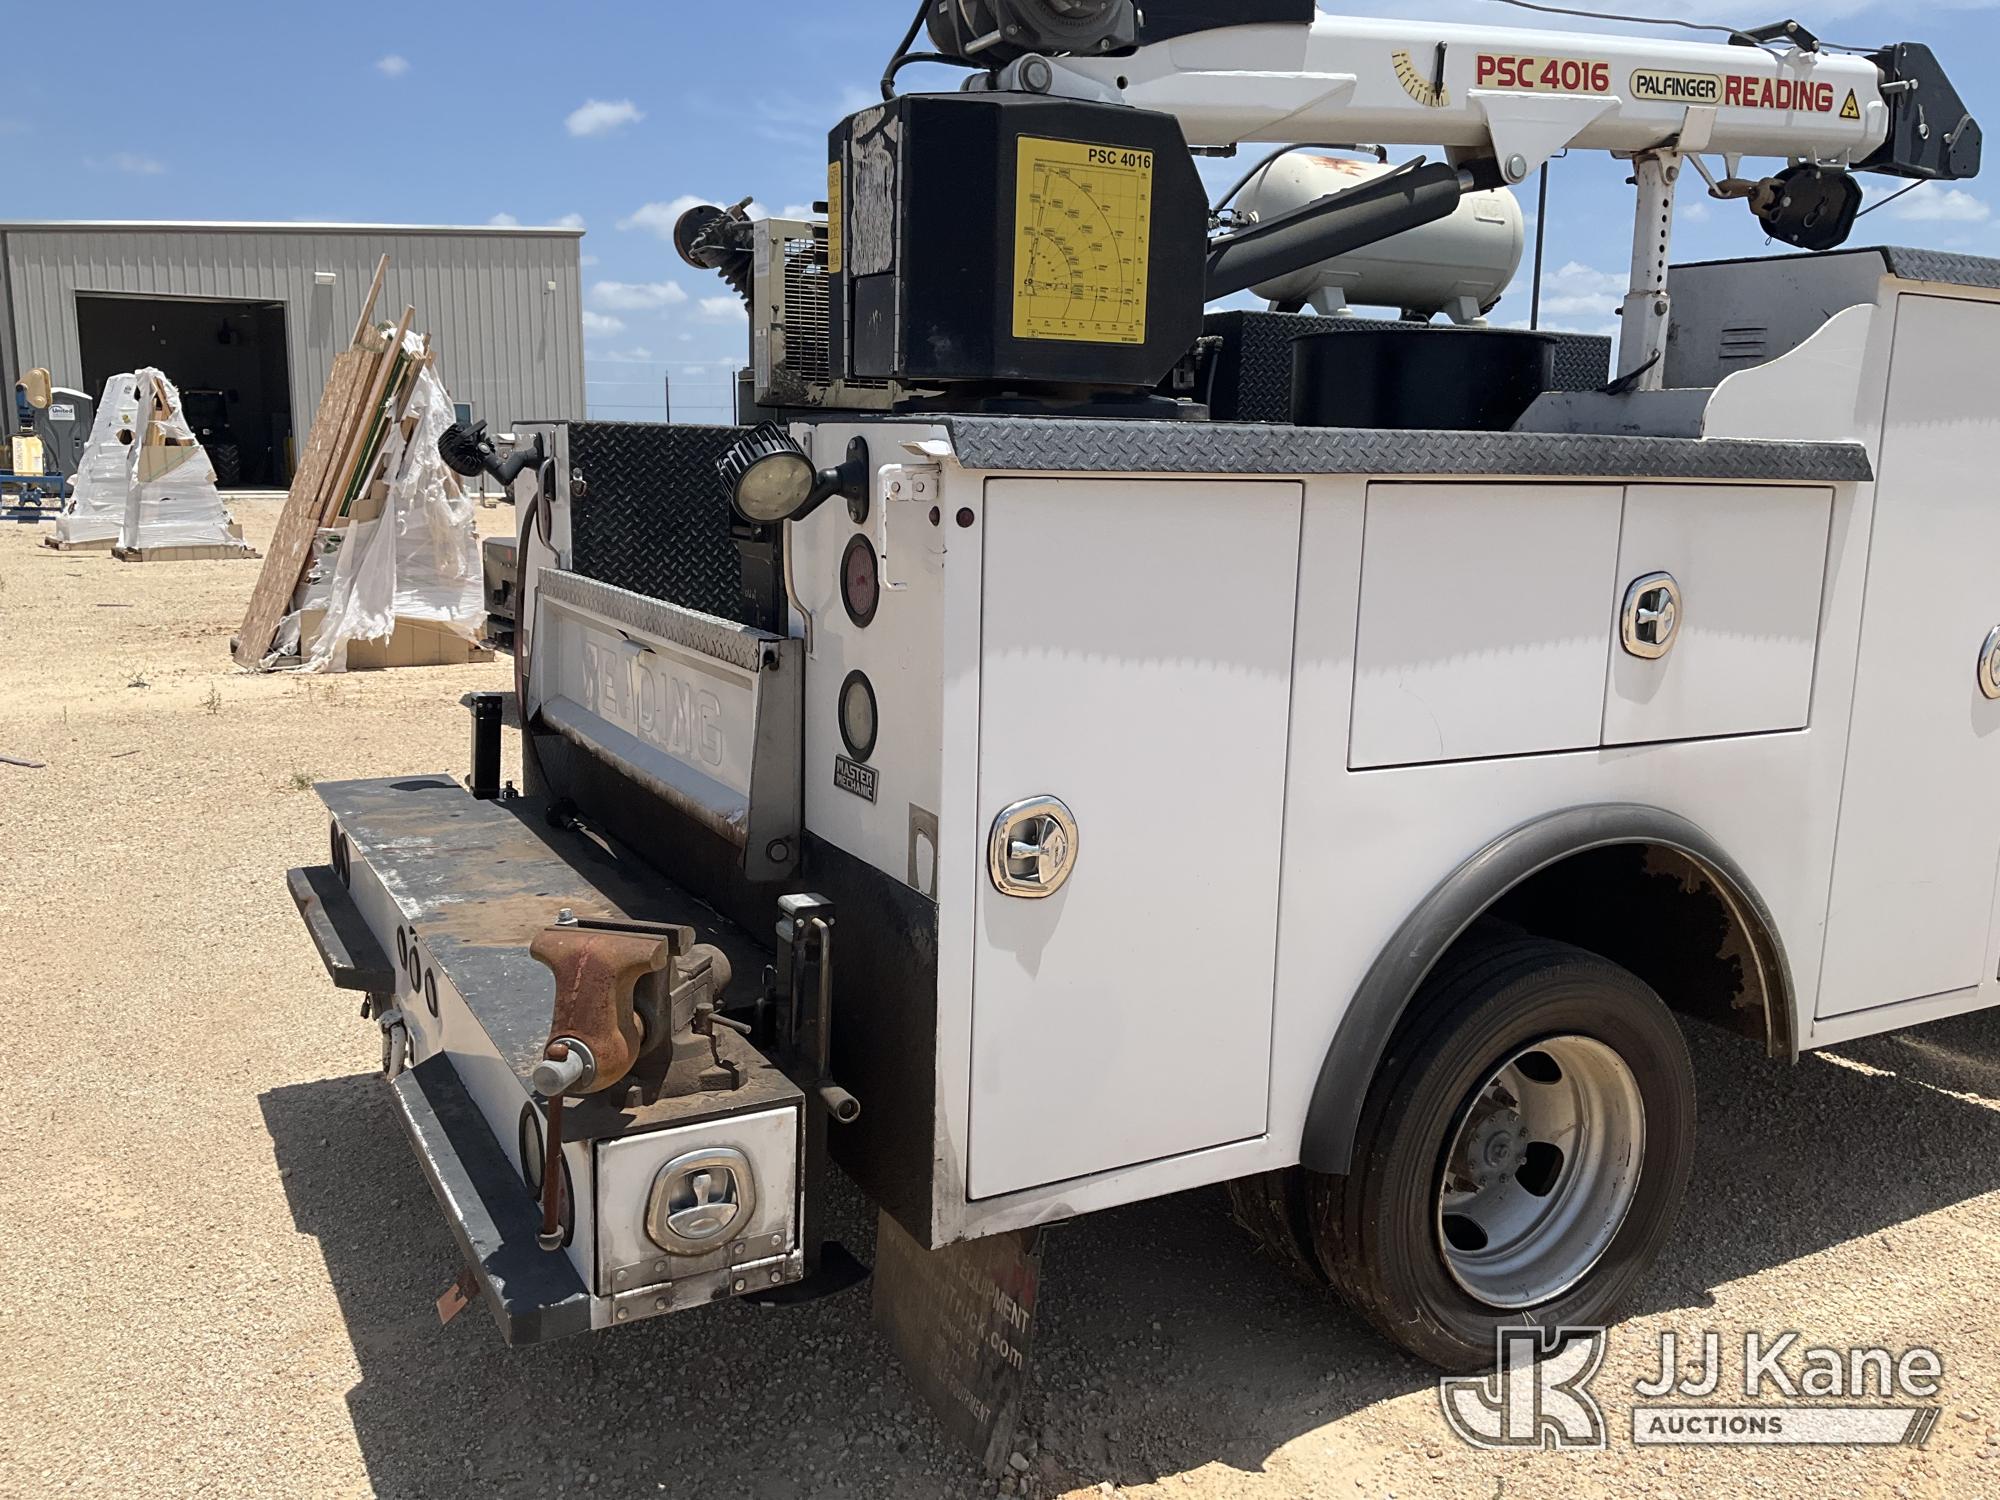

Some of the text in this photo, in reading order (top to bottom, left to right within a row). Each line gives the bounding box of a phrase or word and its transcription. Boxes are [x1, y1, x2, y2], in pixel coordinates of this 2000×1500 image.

[1476, 55, 1534, 89] PSC
[1539, 60, 1609, 92] 4016
[1636, 74, 1834, 112] PALFINGER READING
[1088, 148, 1117, 165] PSC
[1120, 152, 1152, 169] 4016
[583, 641, 723, 767] READING
[836, 759, 873, 787] MASTER
[836, 772, 873, 799] MECHANIC
[959, 1259, 1030, 1334] EQUIPMENT
